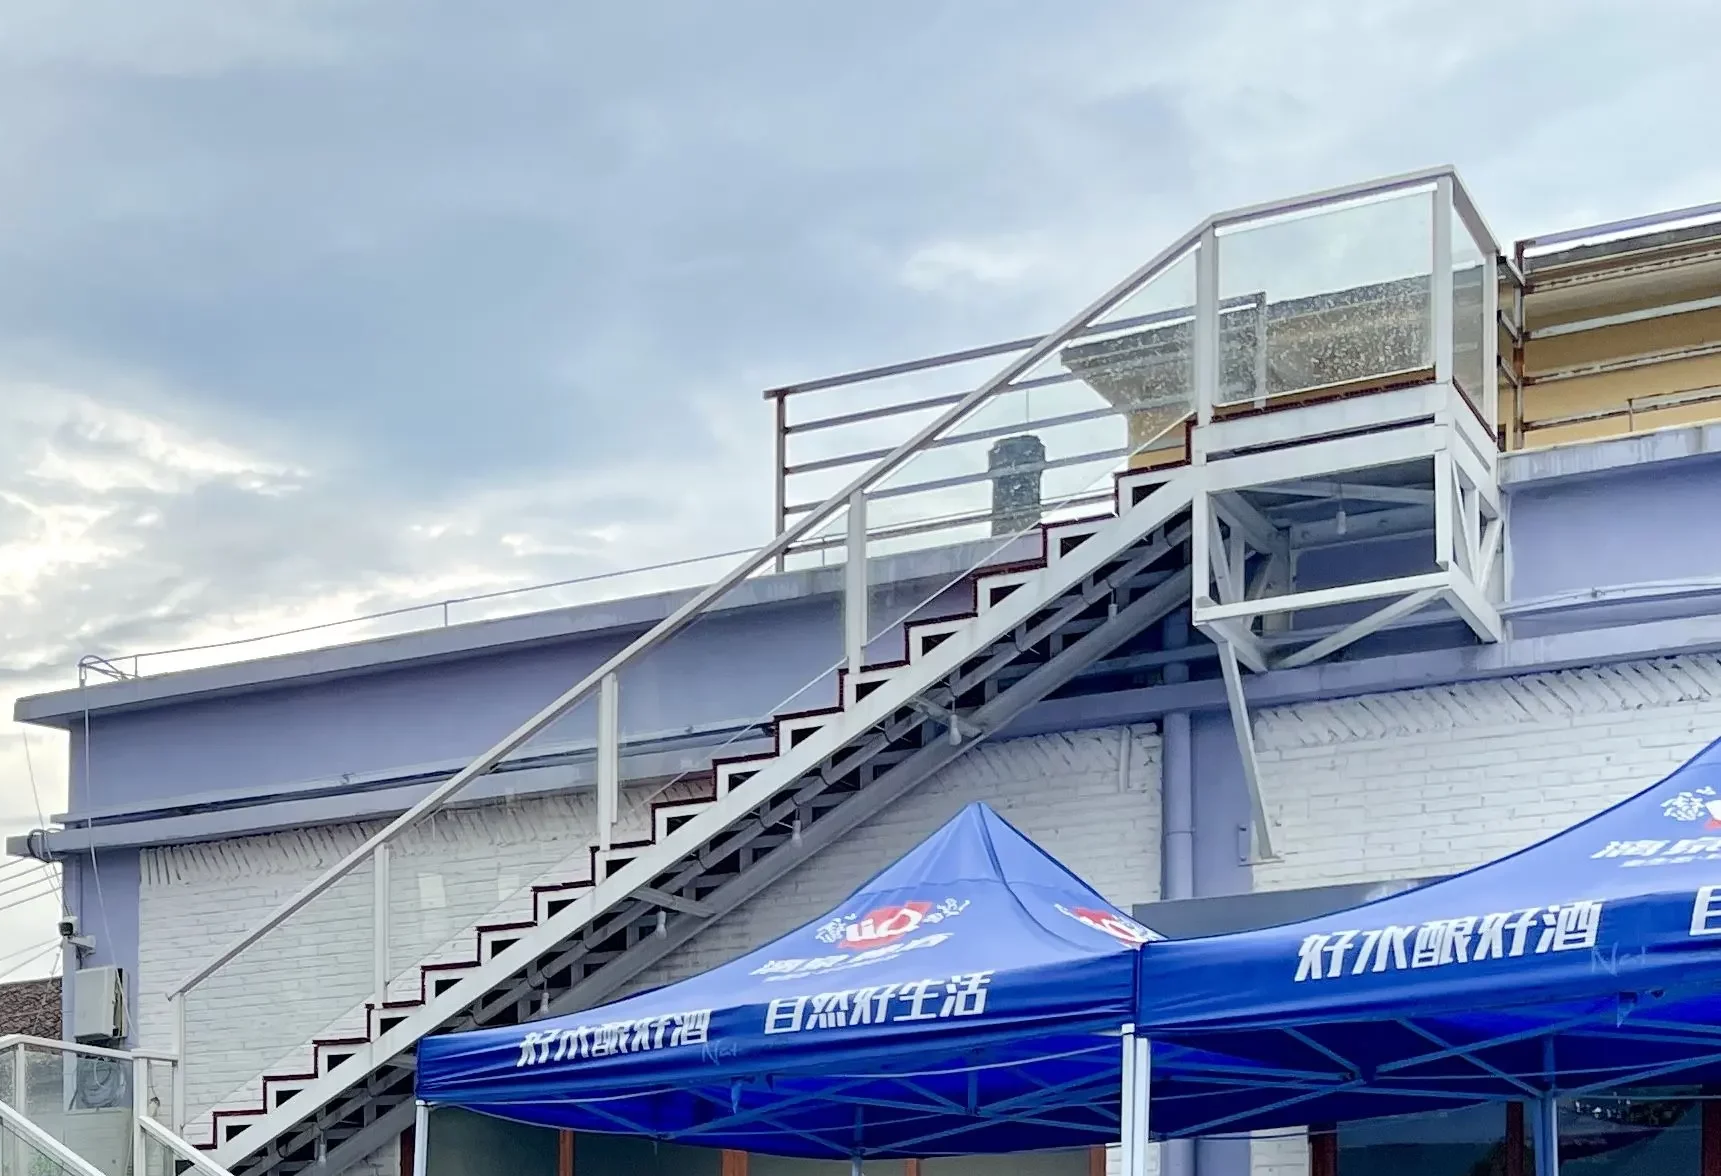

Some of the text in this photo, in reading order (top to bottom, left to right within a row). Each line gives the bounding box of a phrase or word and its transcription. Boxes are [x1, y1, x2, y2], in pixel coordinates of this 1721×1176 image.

[1293, 898, 1606, 983] 好水酿好酒
[516, 969, 996, 1068] 好水酿好酒 自然好生活
